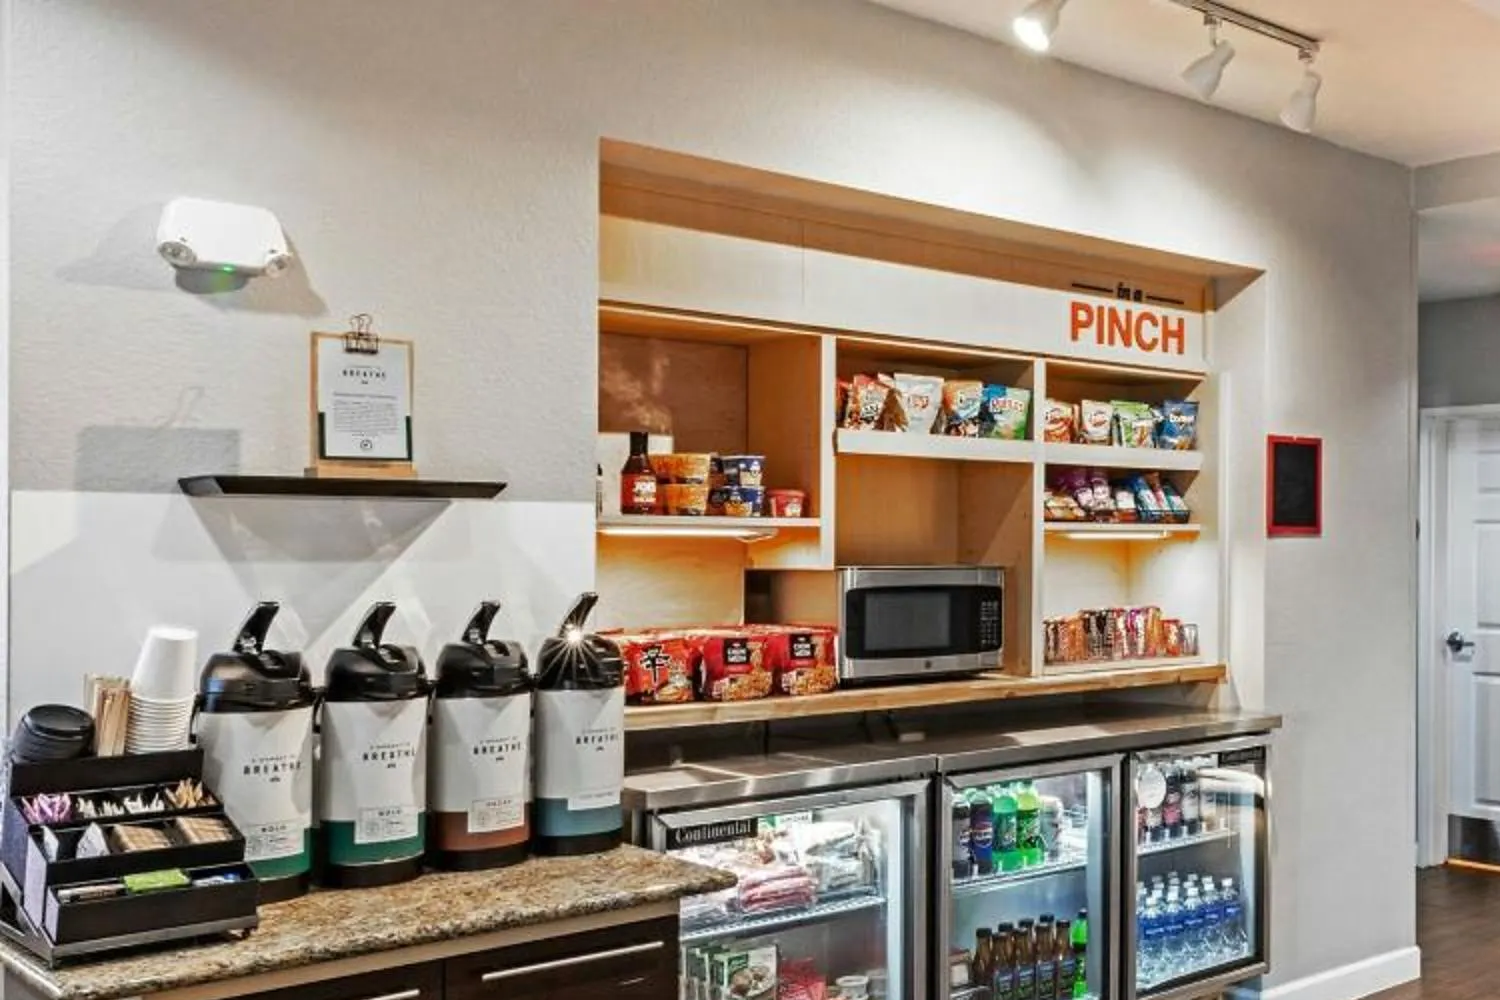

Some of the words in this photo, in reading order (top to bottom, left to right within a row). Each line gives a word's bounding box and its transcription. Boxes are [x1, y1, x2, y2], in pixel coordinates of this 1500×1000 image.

[1071, 301, 1185, 355] PINCH
[243, 761, 301, 775] BREATHE
[675, 819, 751, 843] Continental
